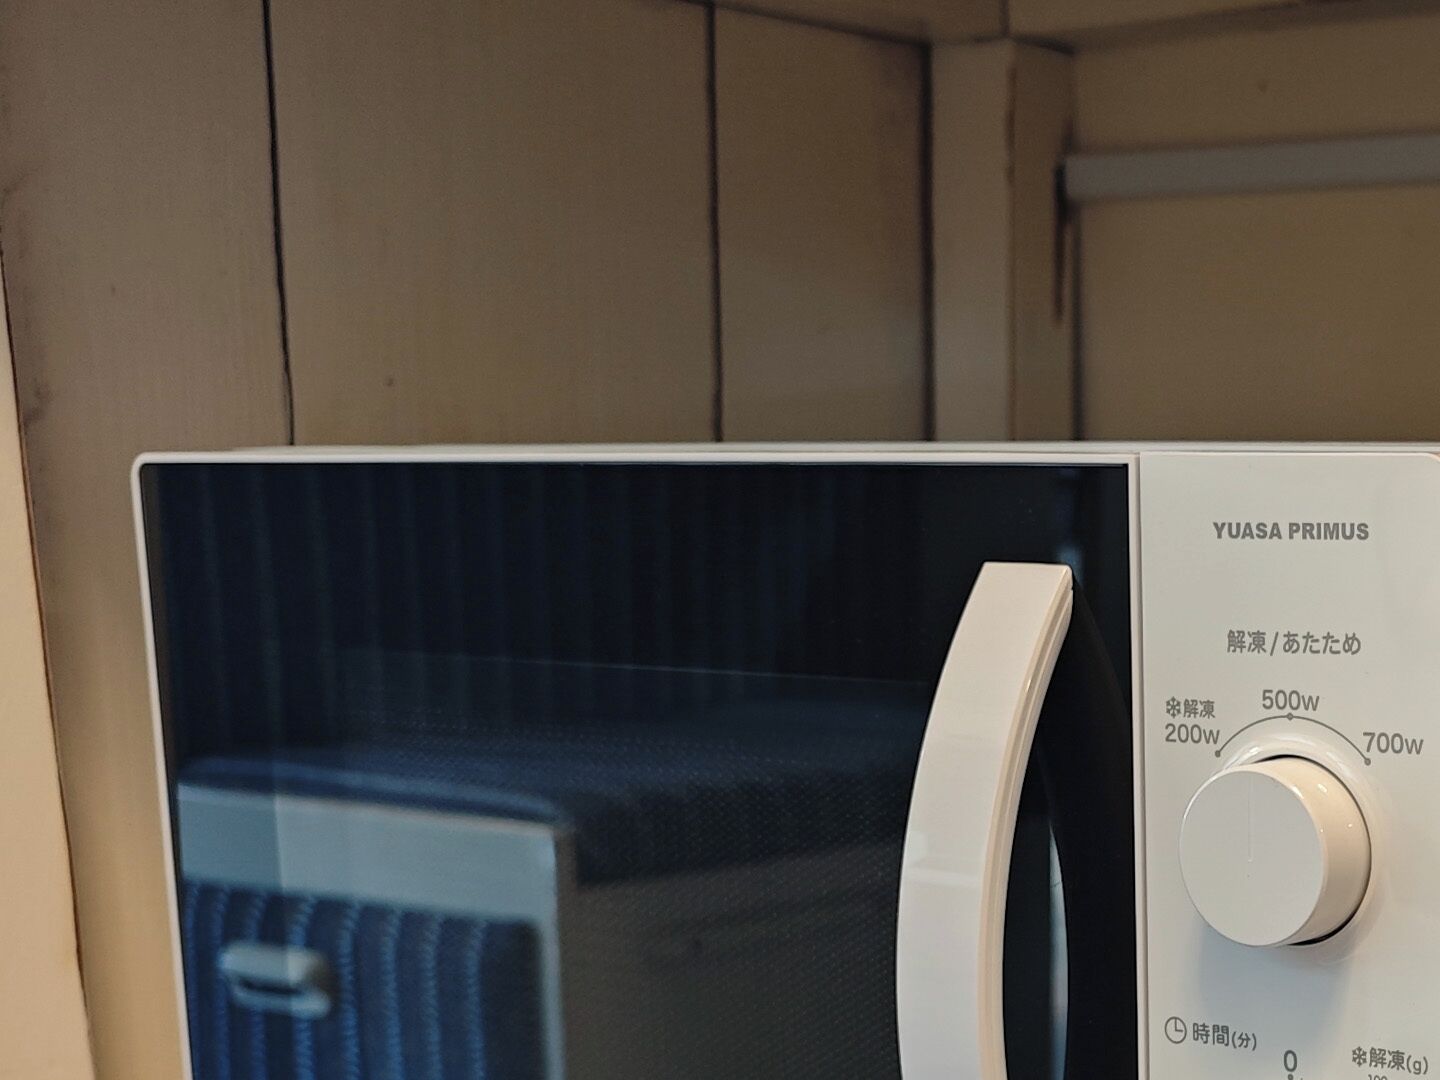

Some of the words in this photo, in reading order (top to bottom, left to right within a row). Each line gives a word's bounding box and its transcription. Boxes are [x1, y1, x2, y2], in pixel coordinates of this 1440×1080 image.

[1212, 522, 1283, 540] YUASA
[1288, 522, 1370, 541] PRIMUS
[1226, 629, 1362, 656] 解凍/あたため
[1183, 699, 1216, 719] 解凍
[1192, 1022, 1257, 1051] 時間(分)
[1283, 1050, 1298, 1072] 0
[1368, 1047, 1429, 1075] 解凍(g)
